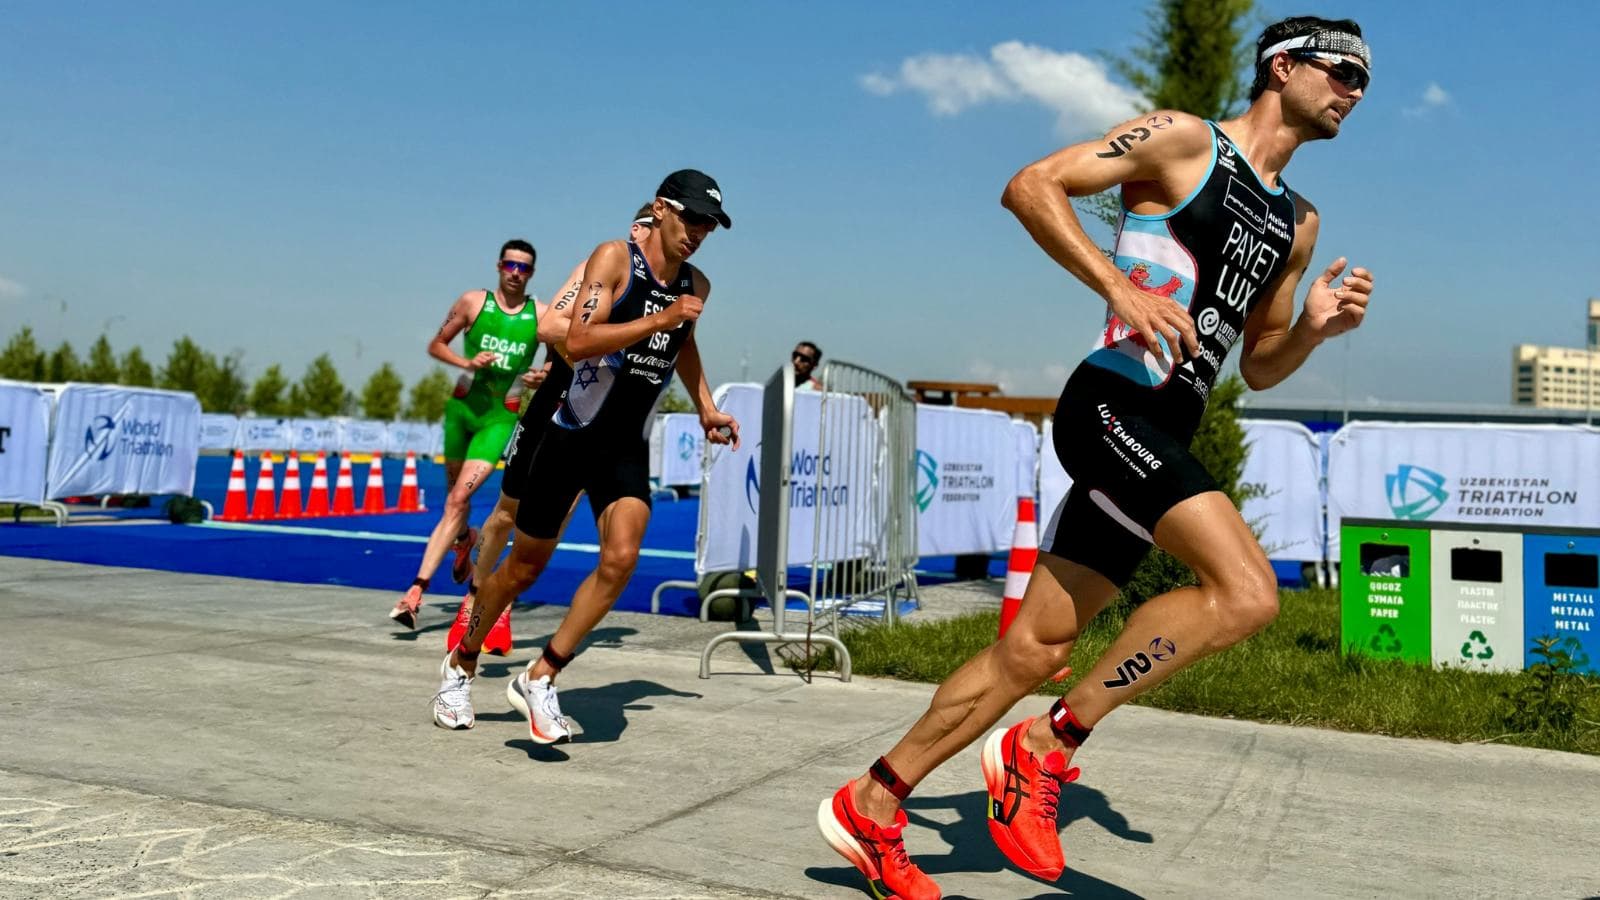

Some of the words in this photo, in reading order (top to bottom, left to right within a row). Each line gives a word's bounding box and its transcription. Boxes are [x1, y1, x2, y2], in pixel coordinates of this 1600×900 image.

[1222, 221, 1280, 284] PAYET
[1216, 264, 1257, 318] LUX
[480, 334, 527, 357] EDGAR
[648, 331, 670, 352] ISR
[491, 352, 512, 370] RL
[122, 419, 161, 437] World
[1097, 403, 1162, 470] LUXEMBOURG
[790, 449, 831, 476] Word
[1460, 477, 1550, 487] UZBEKISTAN
[1459, 489, 1577, 505] TRIATHLON
[1458, 506, 1545, 517] FEDERATION
[1553, 592, 1594, 604] METALL
[1555, 620, 1591, 631] METAL
